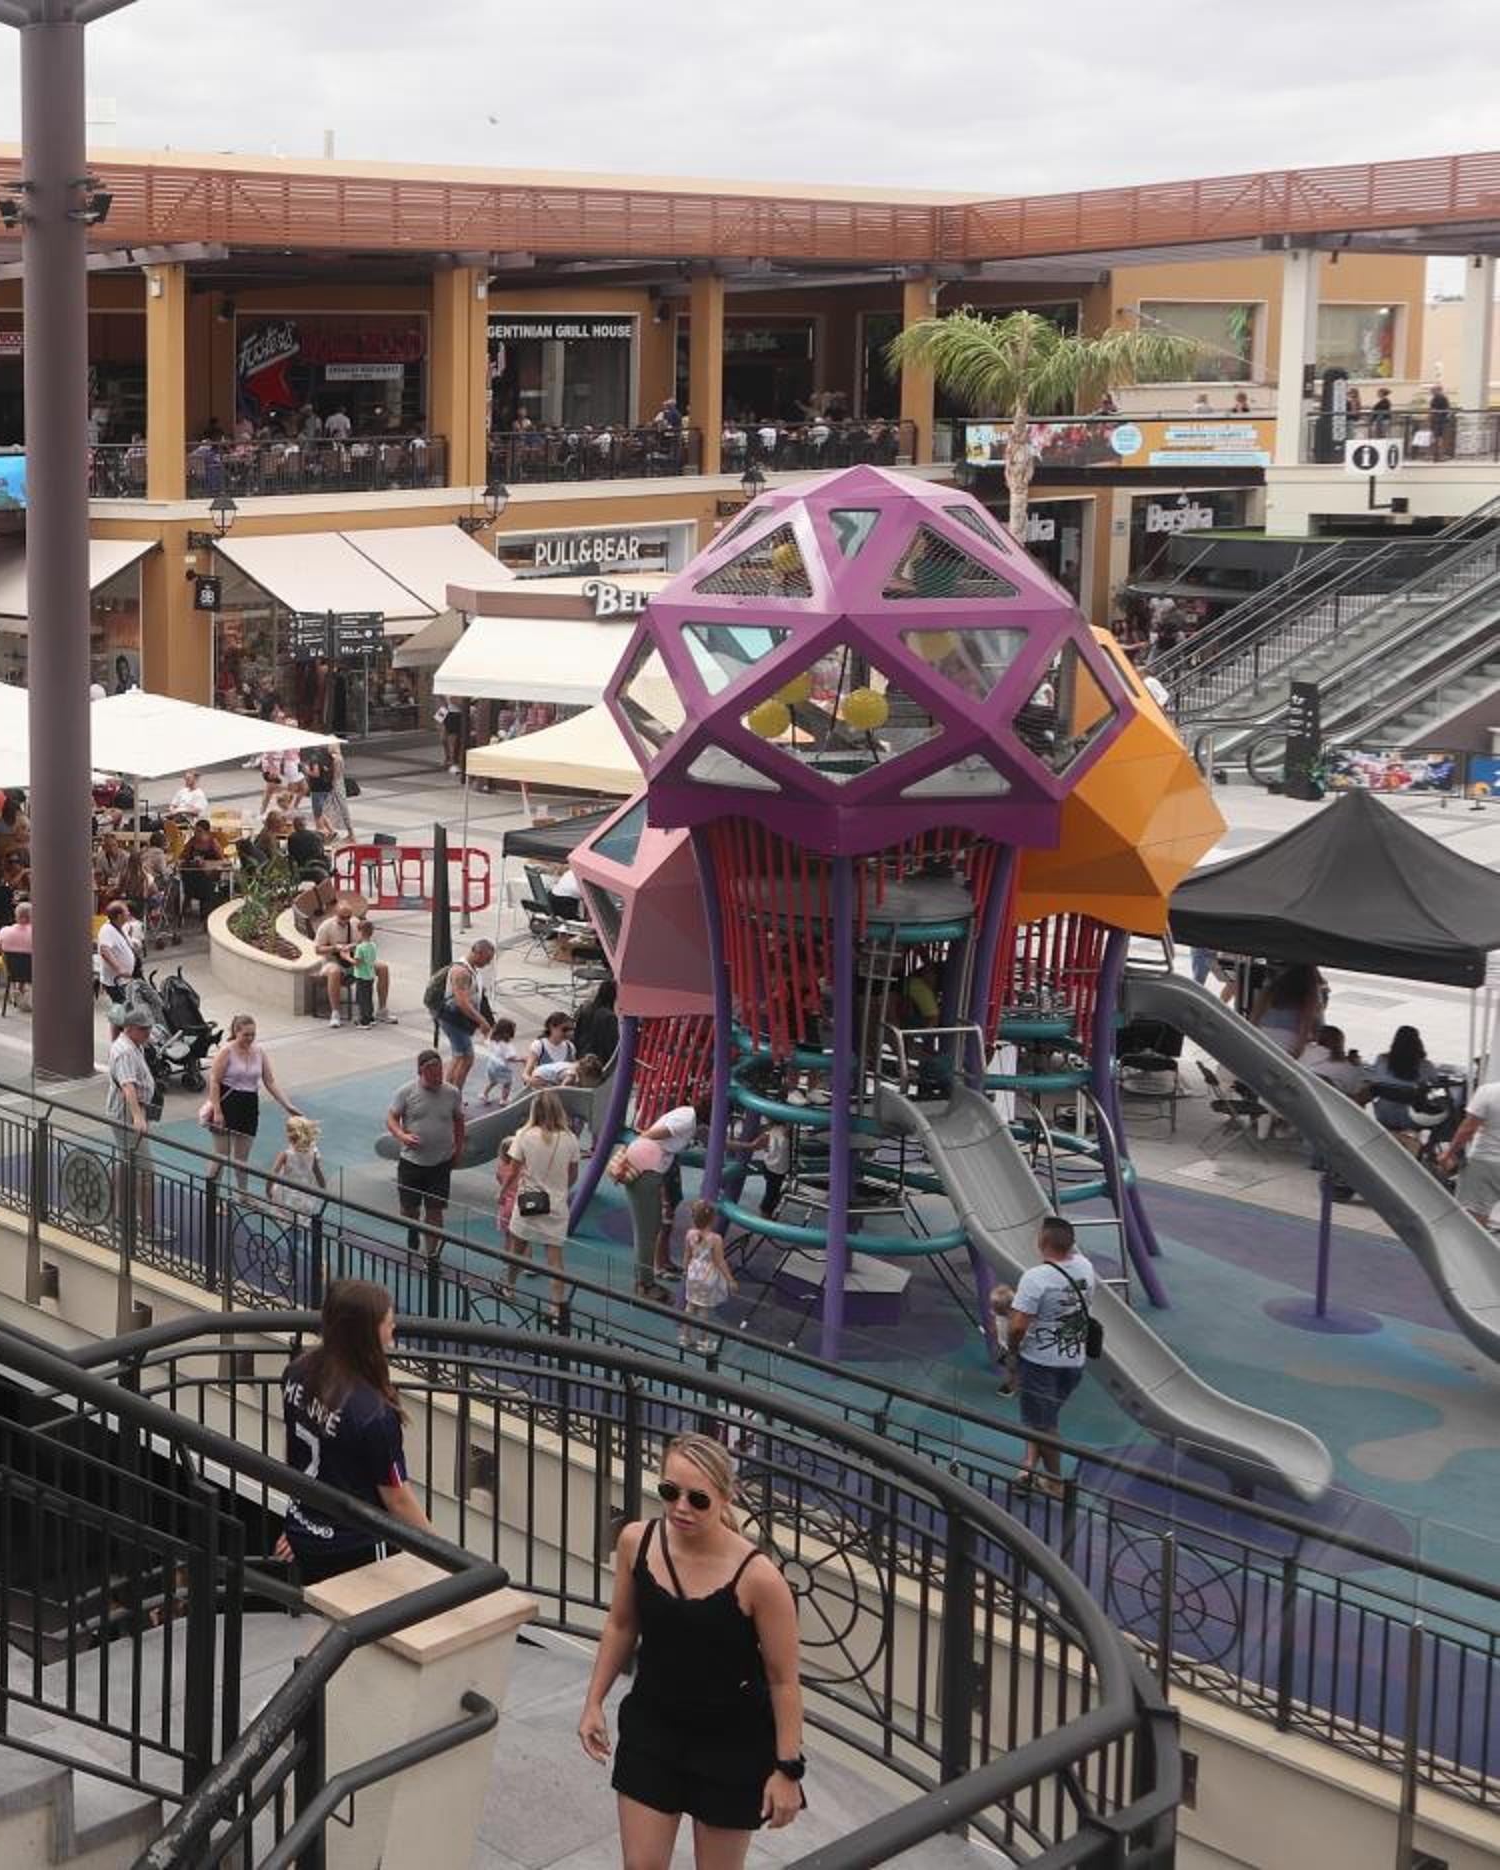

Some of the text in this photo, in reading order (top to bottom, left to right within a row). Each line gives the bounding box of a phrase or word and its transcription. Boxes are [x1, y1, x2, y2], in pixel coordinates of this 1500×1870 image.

[555, 324, 590, 338] GRILL
[592, 324, 633, 338] HOUSE
[535, 535, 641, 567] PULL&BEAR
